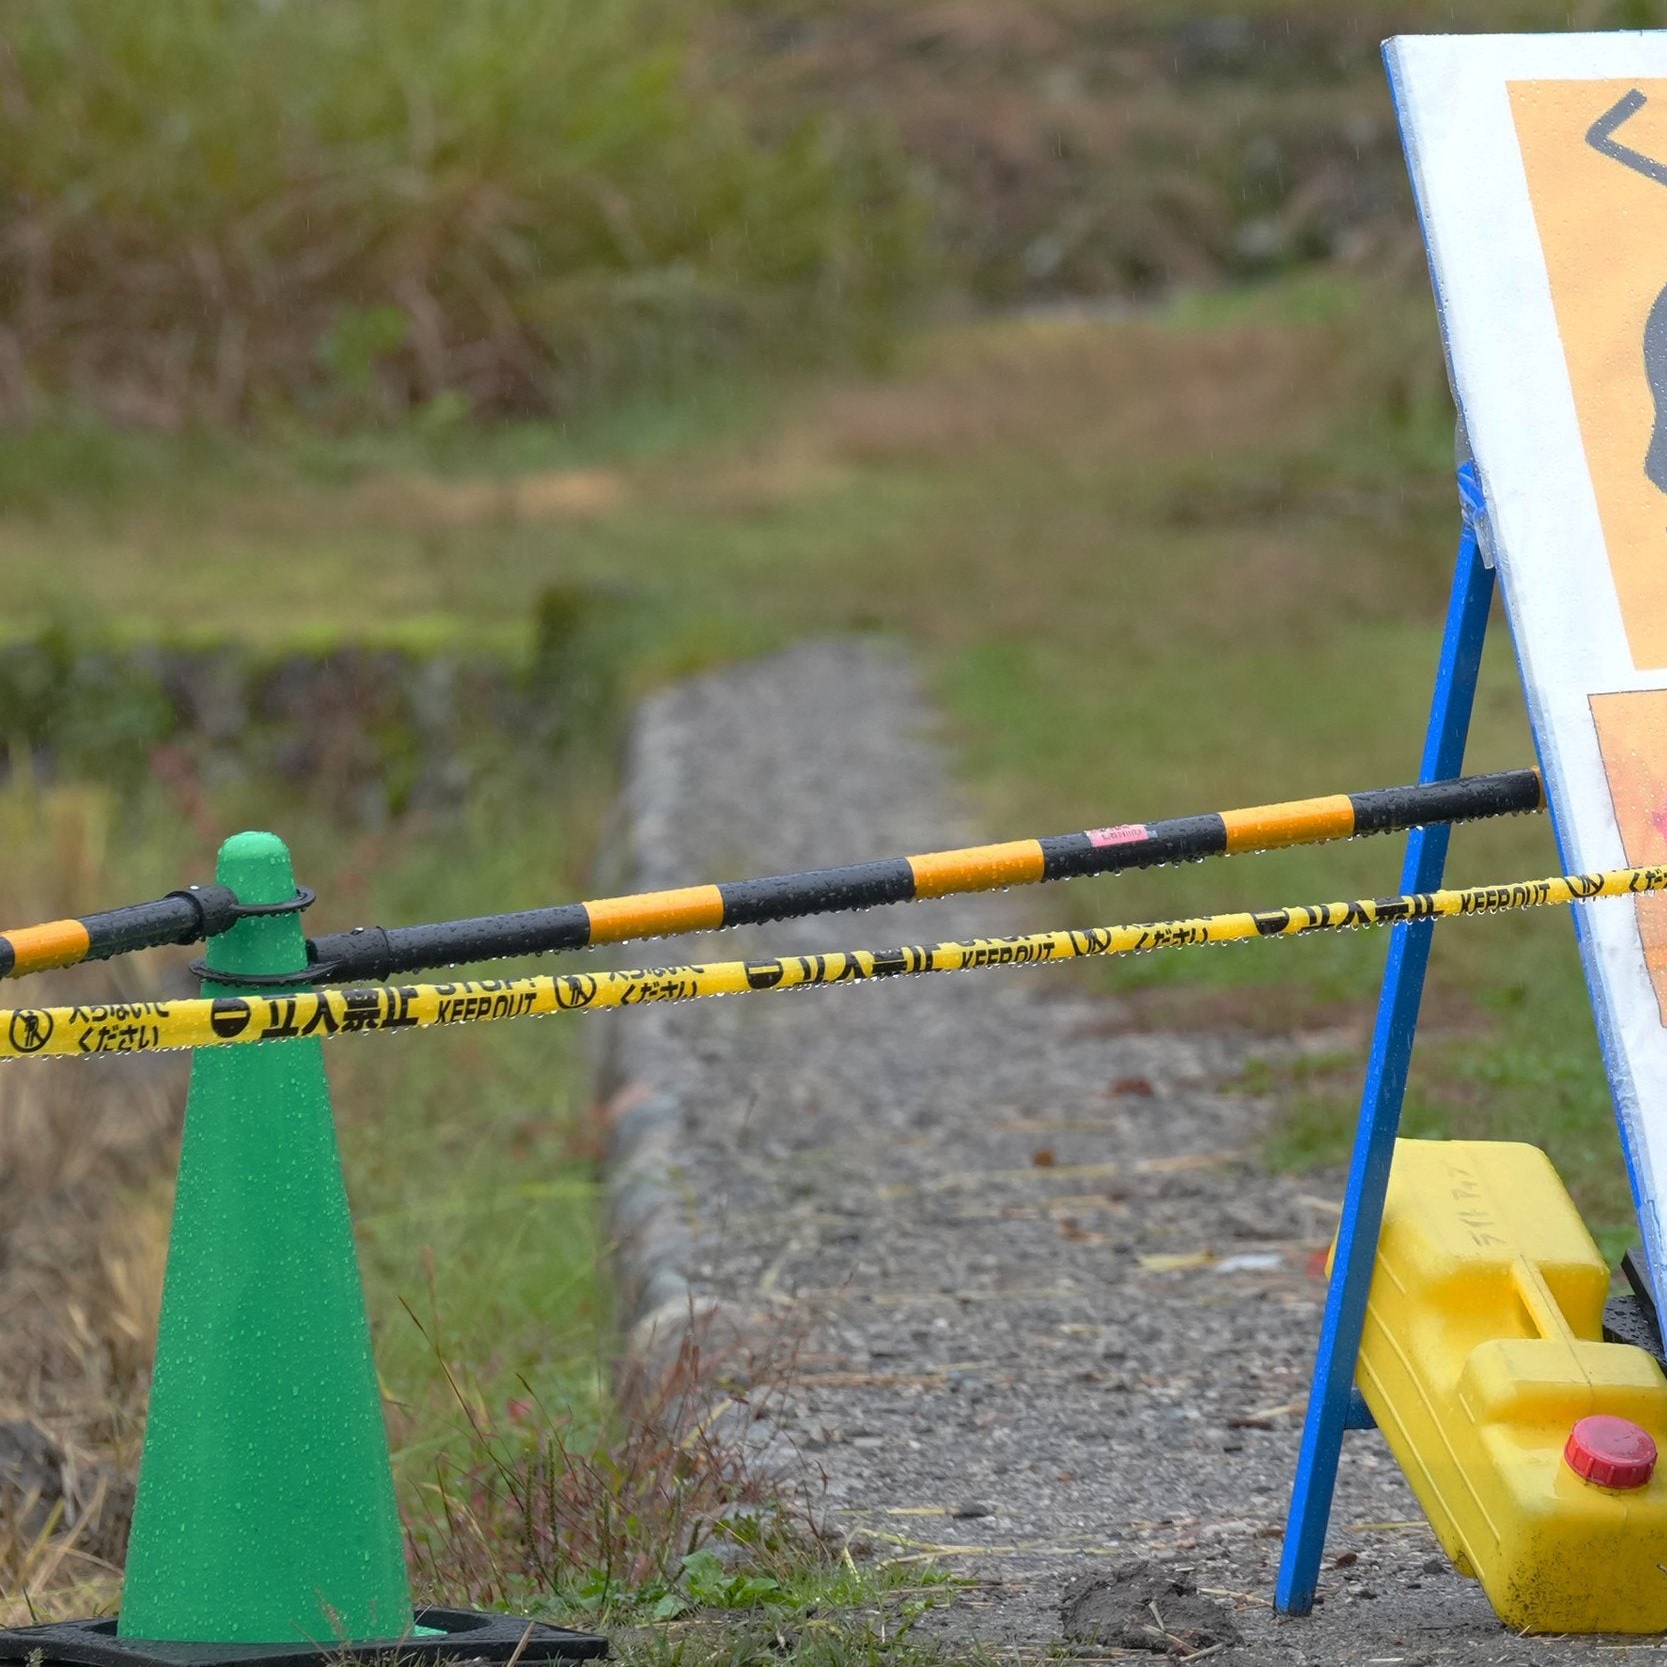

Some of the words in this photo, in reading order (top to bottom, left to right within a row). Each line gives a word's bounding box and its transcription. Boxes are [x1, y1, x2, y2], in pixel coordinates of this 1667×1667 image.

[433, 996, 493, 1024] KEEP
[491, 992, 537, 1019] OUT
[78, 1024, 159, 1052] ください
